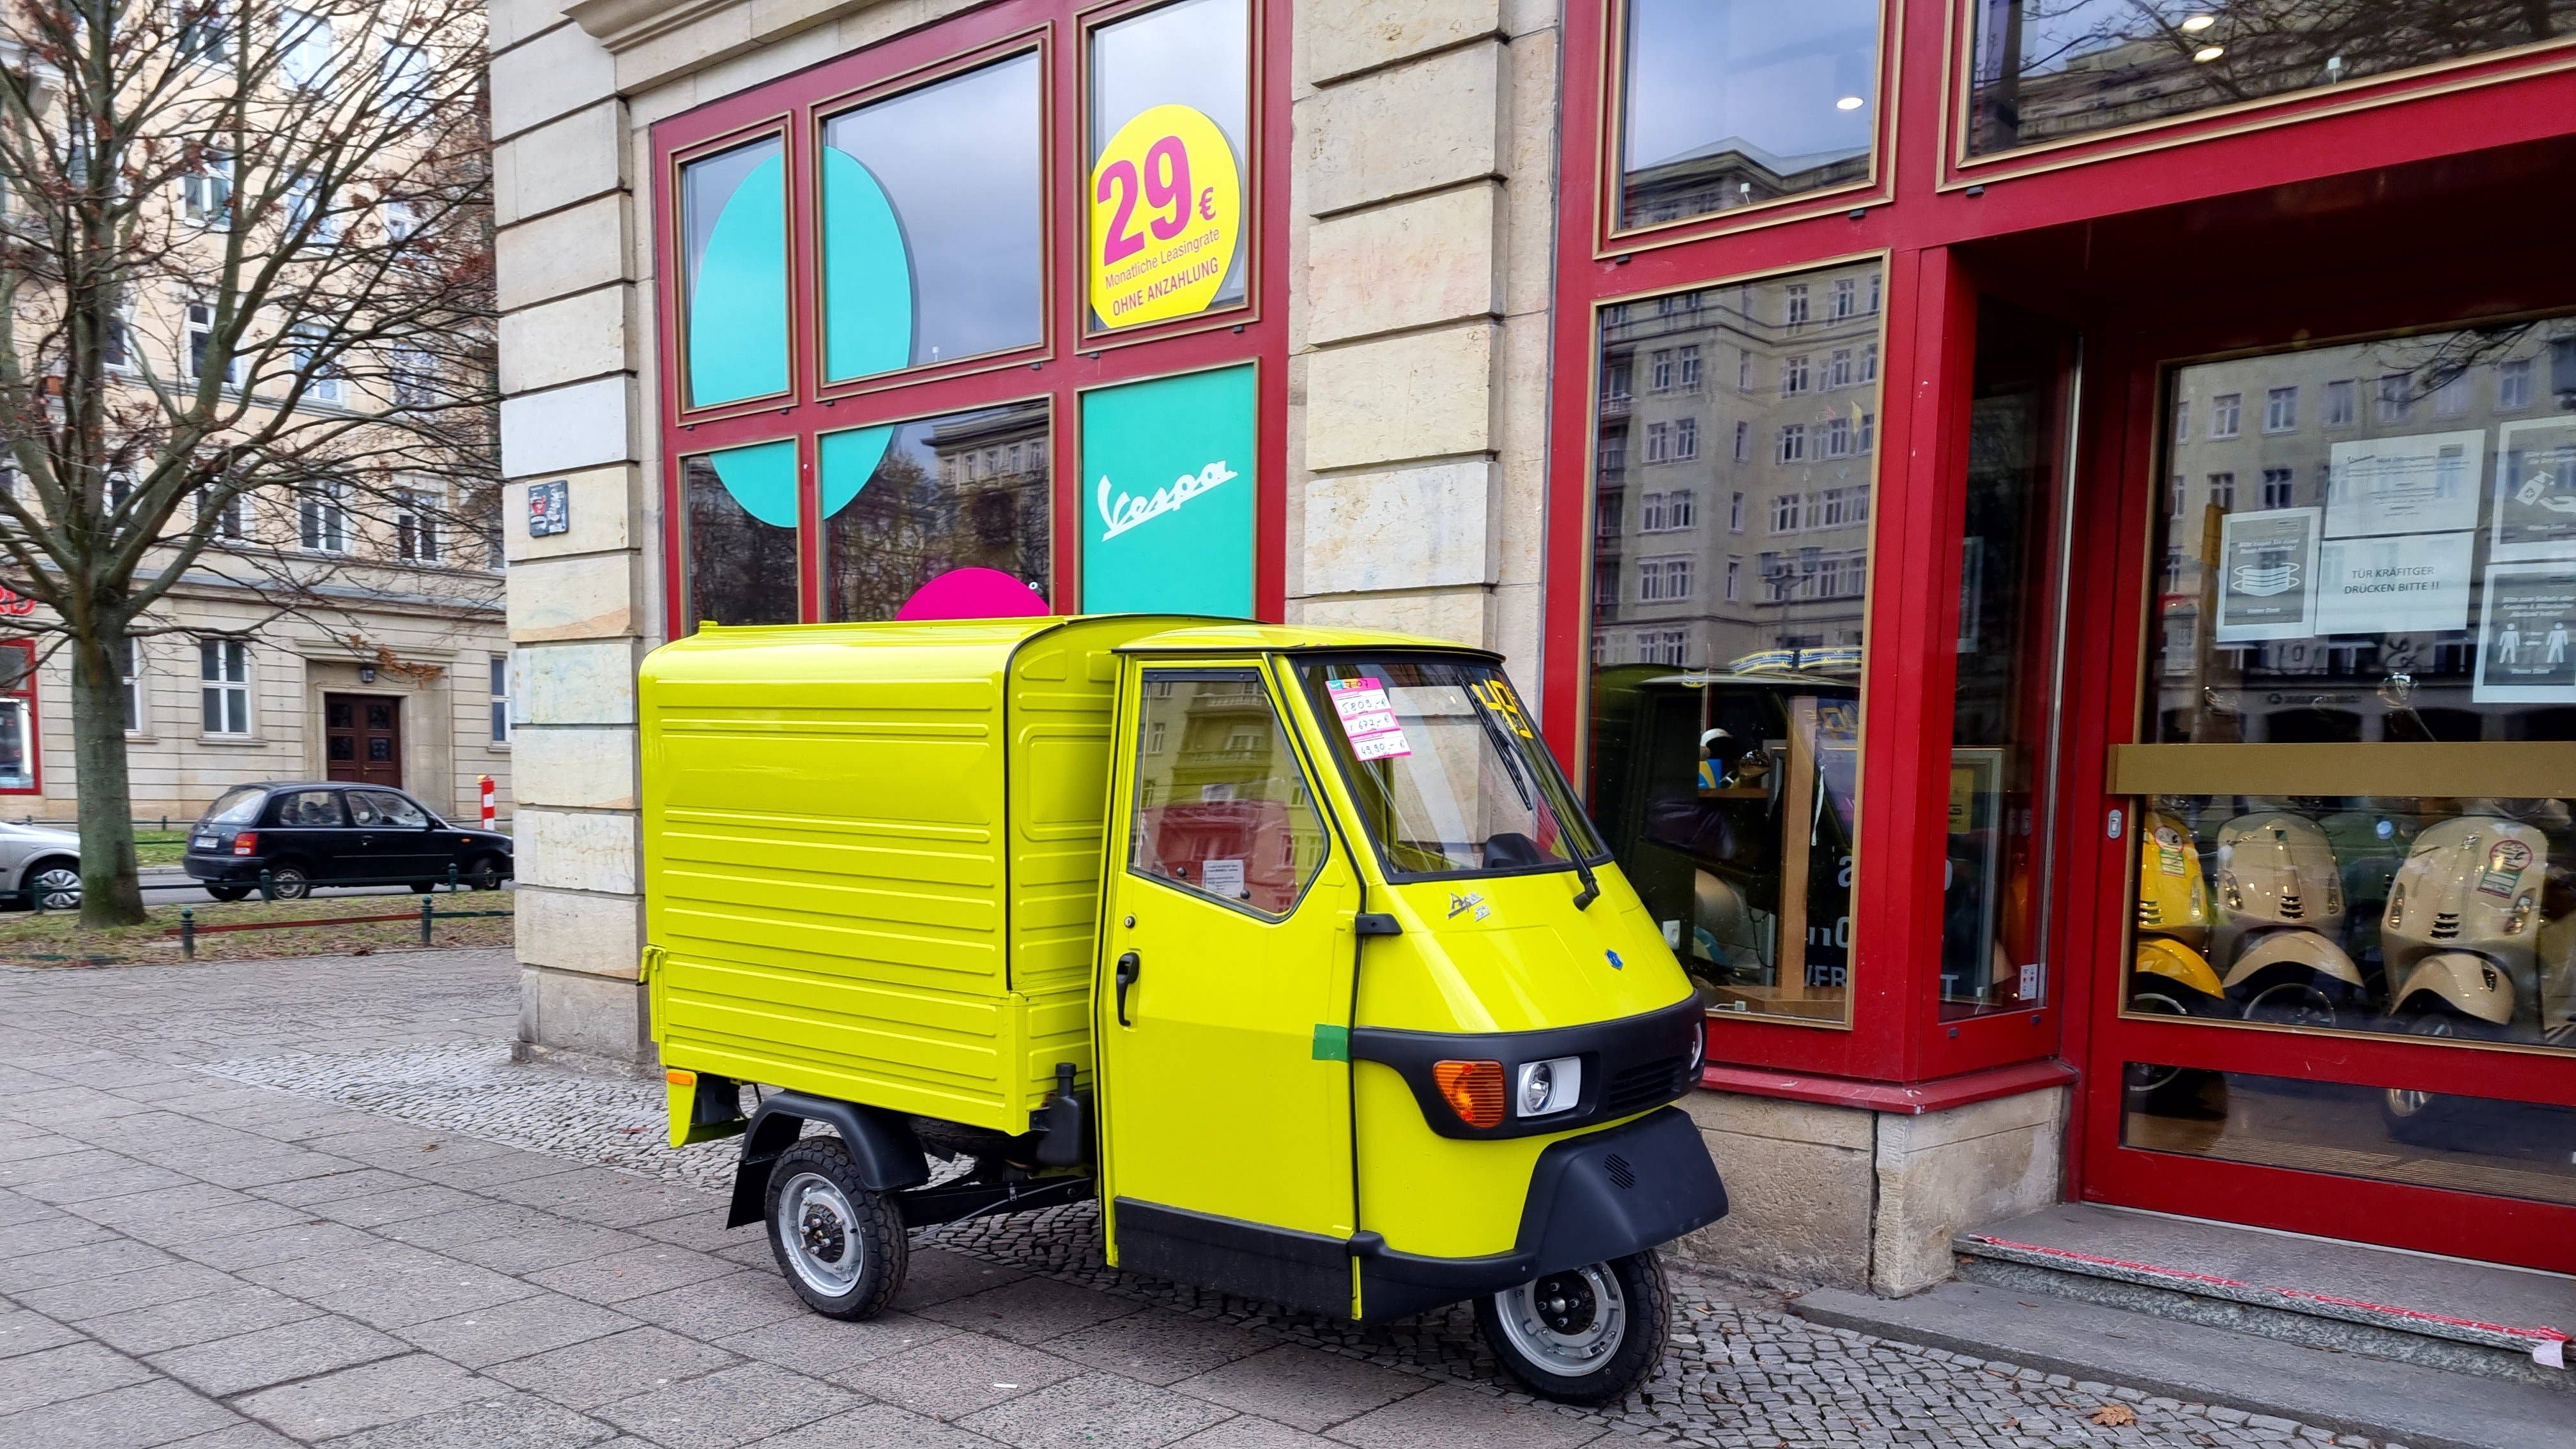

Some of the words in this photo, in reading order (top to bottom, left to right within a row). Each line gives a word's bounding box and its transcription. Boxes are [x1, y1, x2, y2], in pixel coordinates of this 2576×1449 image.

[1097, 135, 1192, 267] 29
[1199, 187, 1216, 221] €
[1105, 256, 1158, 289] Monatliche
[1160, 229, 1220, 264] Leasingrate
[1113, 294, 1144, 317] OHNE
[1147, 257, 1219, 302] ANZAHLUNG
[1097, 460, 1239, 542] Vespa
[2344, 583, 2395, 594] DRÜCKEN
[2398, 581, 2428, 592] BITTE
